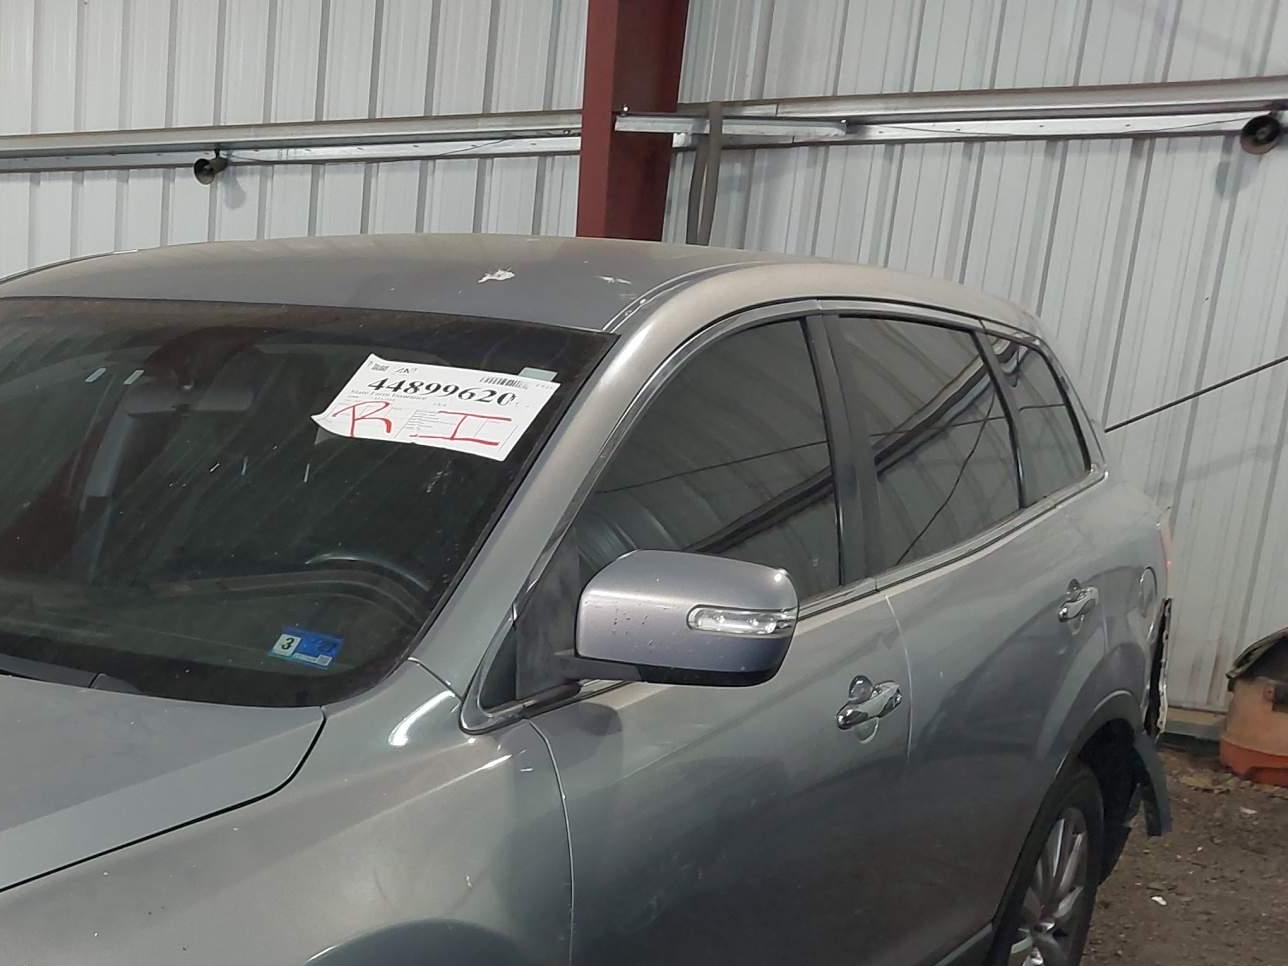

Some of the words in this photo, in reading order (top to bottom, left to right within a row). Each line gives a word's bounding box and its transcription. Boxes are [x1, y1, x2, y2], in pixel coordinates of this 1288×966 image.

[368, 378, 516, 406] 44899620
[332, 400, 392, 438] R
[281, 637, 295, 650] 3
